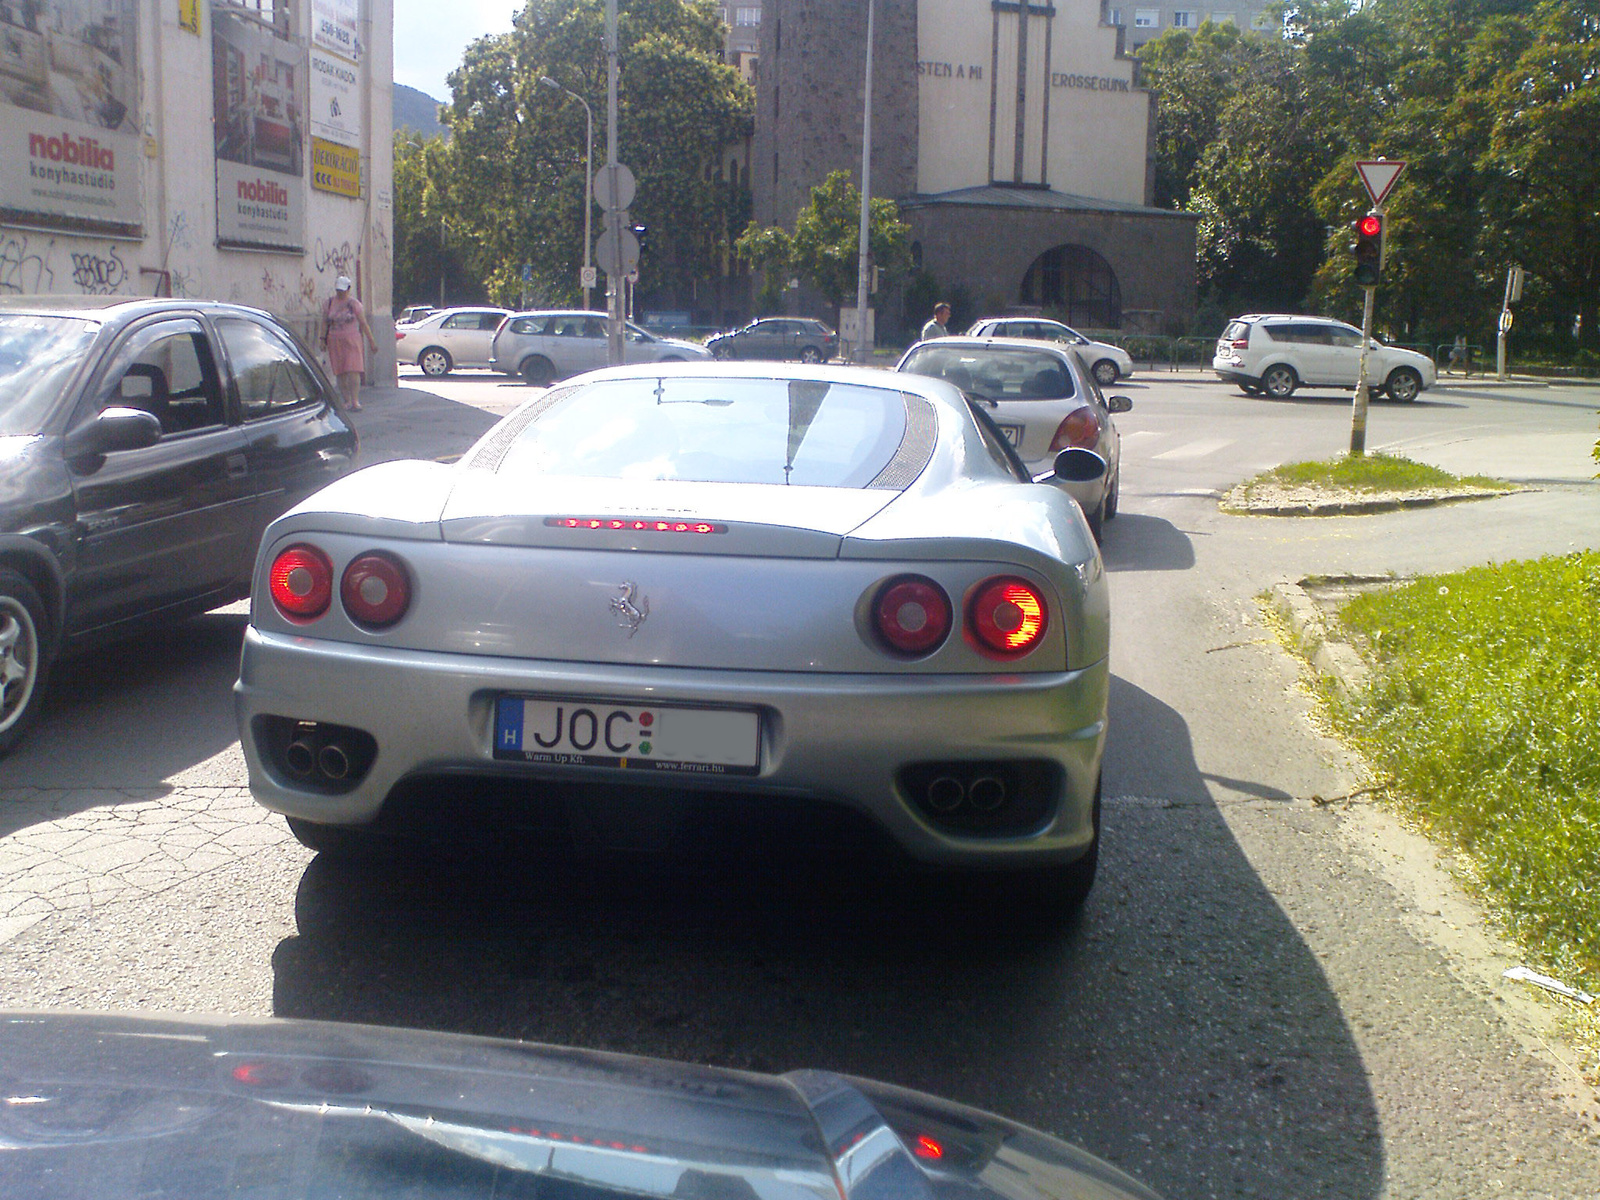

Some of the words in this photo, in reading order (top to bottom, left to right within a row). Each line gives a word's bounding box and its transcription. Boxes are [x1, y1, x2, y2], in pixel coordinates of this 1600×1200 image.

[956, 64, 965, 78] A
[969, 65, 983, 79] MI
[28, 131, 115, 172] nobilia
[236, 178, 288, 207] nobilia
[504, 728, 516, 745] H
[525, 751, 552, 761] Warm
[554, 753, 567, 764] Up
[569, 754, 586, 765] Kft.
[655, 761, 725, 773] www.ferrari.hu
